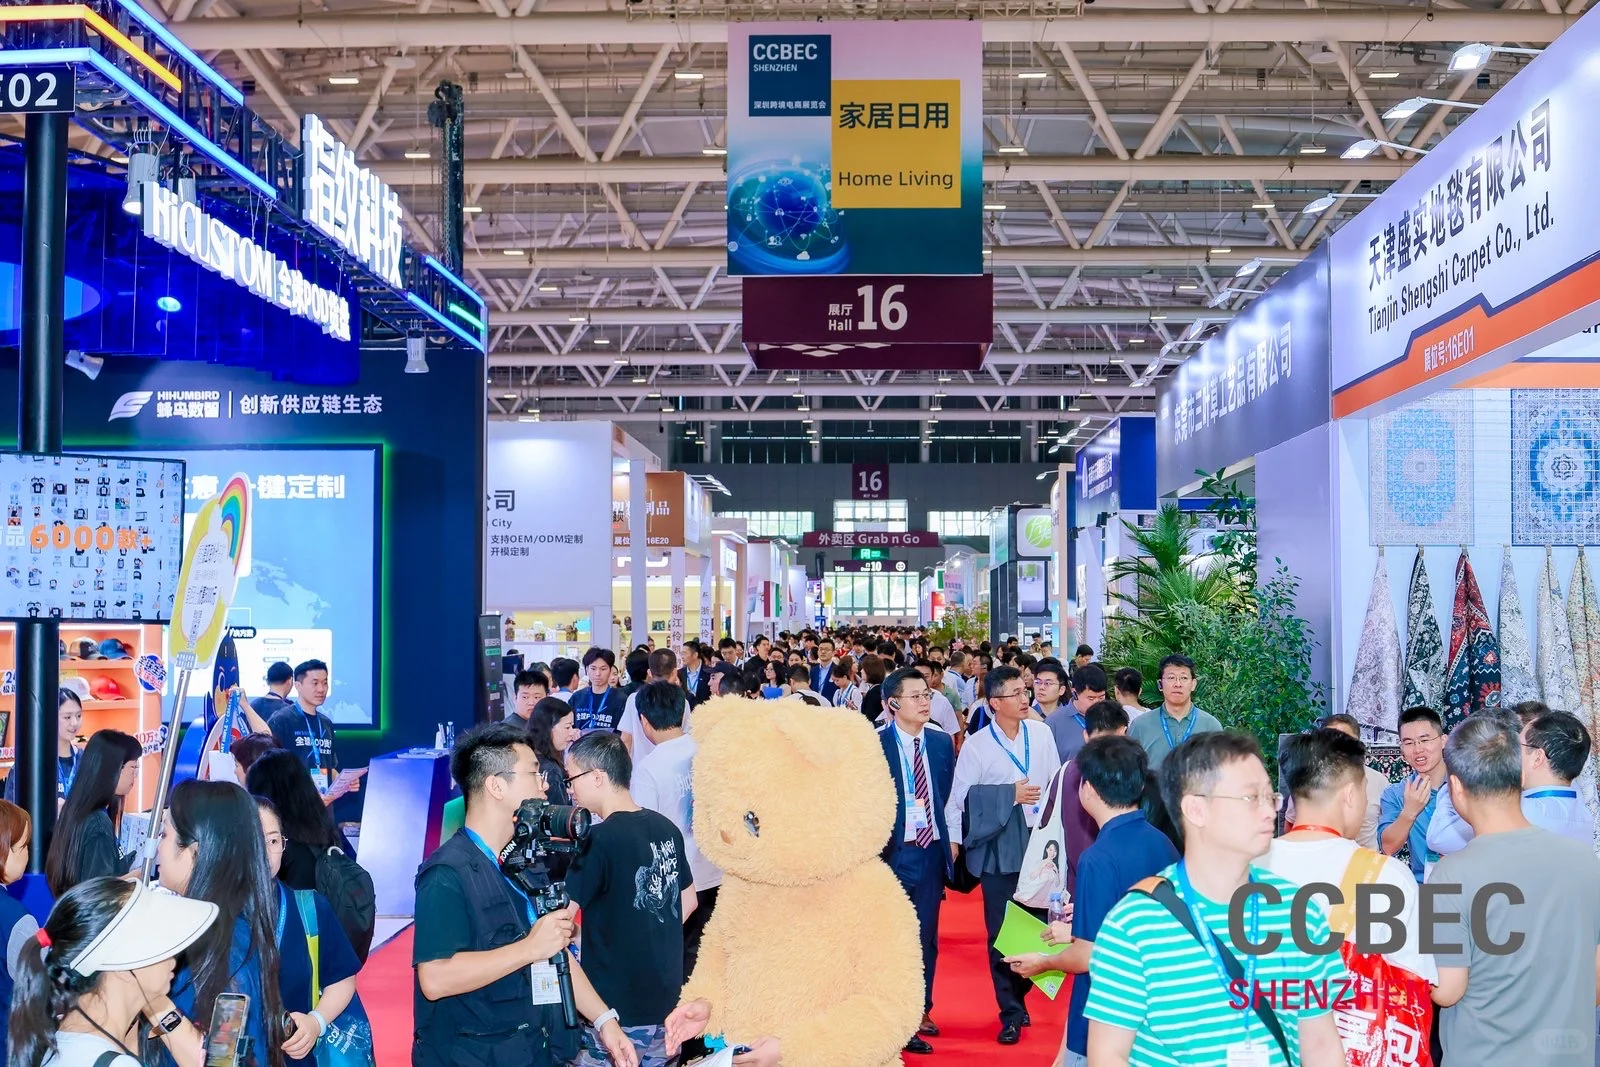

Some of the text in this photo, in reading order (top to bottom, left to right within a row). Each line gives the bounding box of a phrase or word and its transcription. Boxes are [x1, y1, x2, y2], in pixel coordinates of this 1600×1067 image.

[753, 43, 818, 61] CCBEC
[753, 63, 798, 72] SHENZHEN
[0, 72, 58, 107] 02
[753, 100, 827, 110] 深圳跨境电商展览会
[839, 102, 949, 129] 家居日用
[839, 170, 953, 189] Home Living
[306, 114, 403, 289] 指纹科技
[1369, 98, 1551, 292] 天津盛实地毯有限公司
[1368, 192, 1554, 335] Tianjin Shengshi Carpet Co., Ltd.
[828, 303, 853, 316] 展厅
[857, 284, 908, 331] 16
[828, 318, 852, 331] Hall
[1424, 325, 1475, 372] 展位号:16E01
[1174, 320, 1292, 446] 东莞市三叶草工艺品有限公司
[157, 391, 220, 401] HIHUMBIRD
[157, 394, 382, 419] 蜂鸟数智 创新供应链生态
[859, 471, 882, 491] 16
[487, 490, 515, 512] 司
[491, 518, 512, 529] City
[490, 534, 584, 544] 支持OEM/ODM定制
[819, 533, 920, 545] 外卖区 Grab n Go
[490, 547, 530, 557] 开模定制
[870, 561, 882, 572] 10
